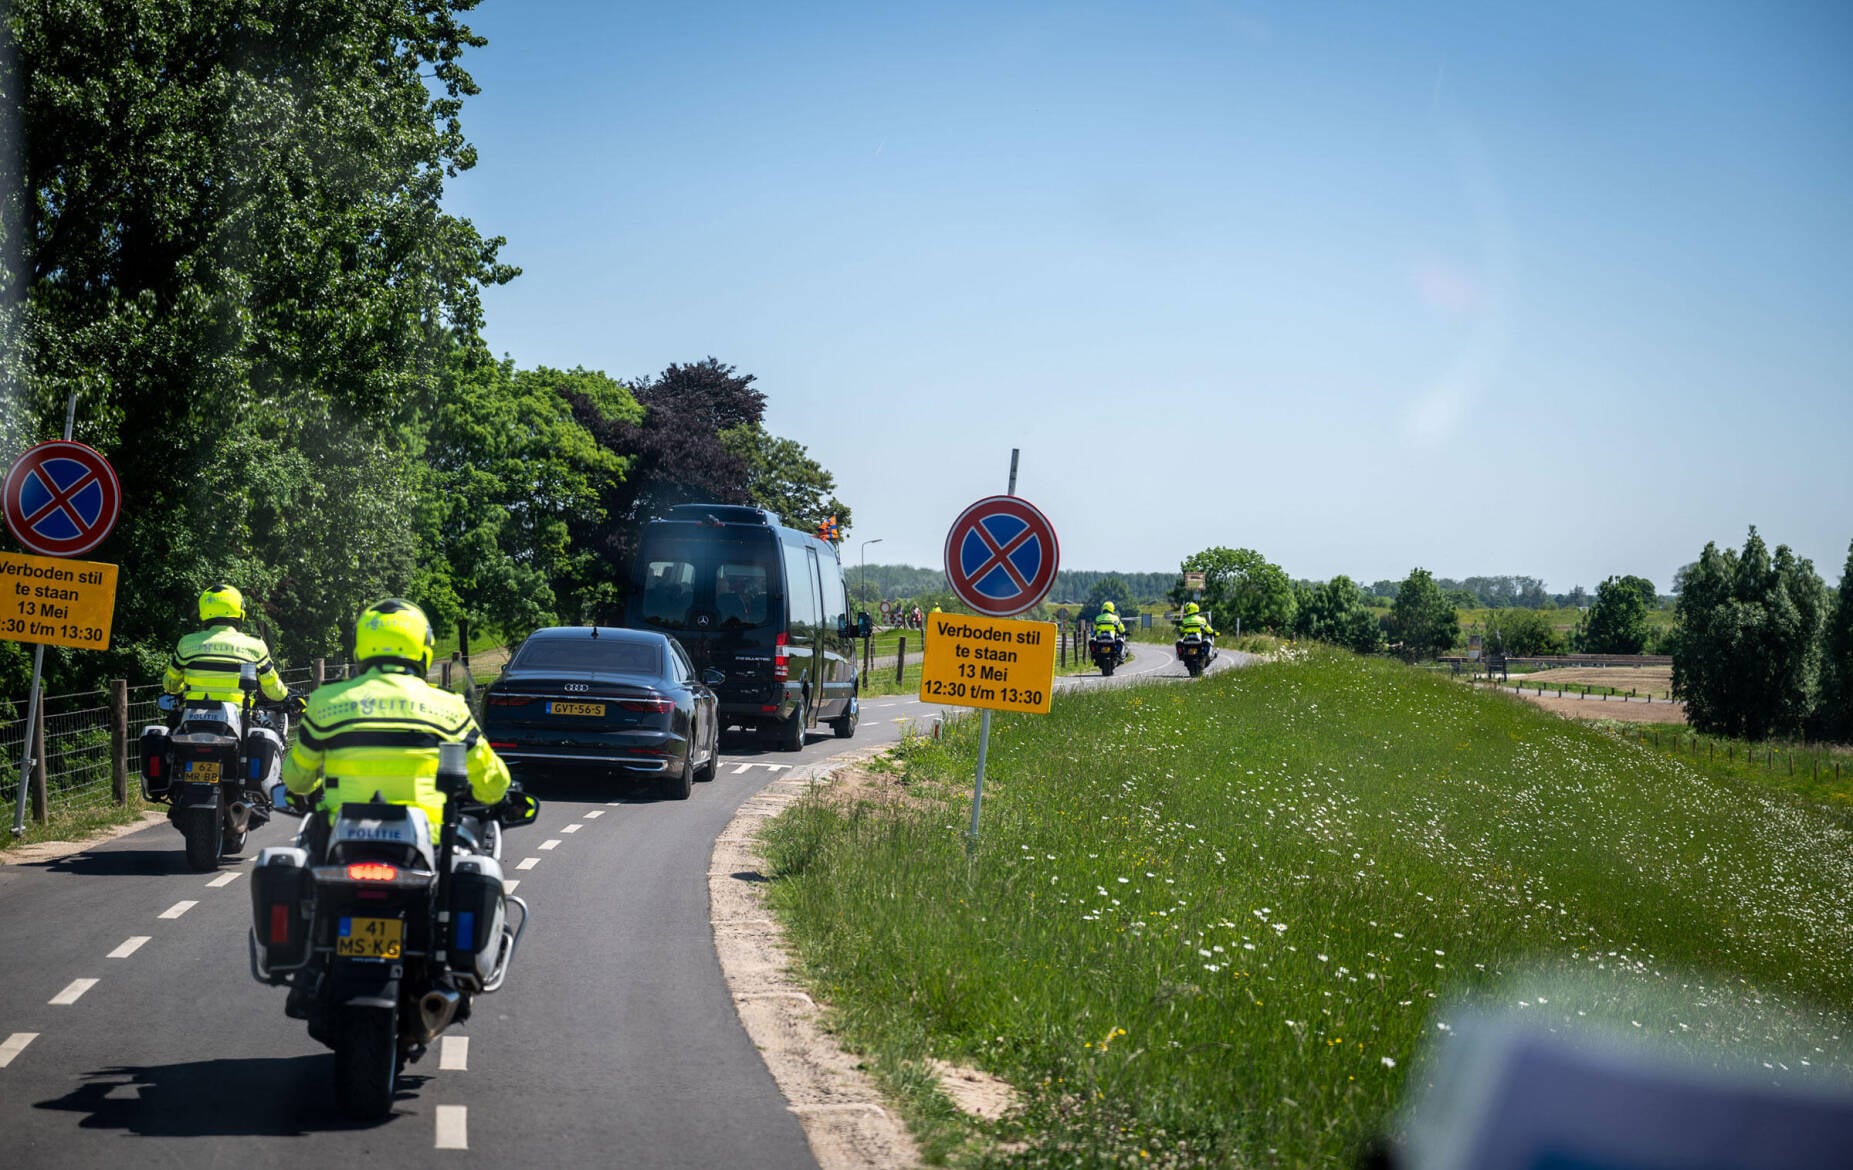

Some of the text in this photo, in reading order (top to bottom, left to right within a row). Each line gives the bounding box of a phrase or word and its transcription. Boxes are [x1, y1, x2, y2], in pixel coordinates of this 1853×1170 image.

[78, 571, 103, 585] stil
[15, 582, 79, 601] te staan
[17, 601, 69, 619] 13 Mei
[0, 619, 103, 642] :30 t/m 13:30
[937, 621, 1041, 645] Verboden stil
[955, 644, 1018, 663] te staan
[958, 663, 1008, 682] 13 Mei
[925, 679, 1043, 706] 12:30 t/m 13:30
[350, 695, 427, 715] POLITIE
[188, 713, 218, 721] POLITIE
[198, 763, 213, 773] 62
[347, 828, 401, 839] POLITIE
[365, 920, 386, 937] 41
